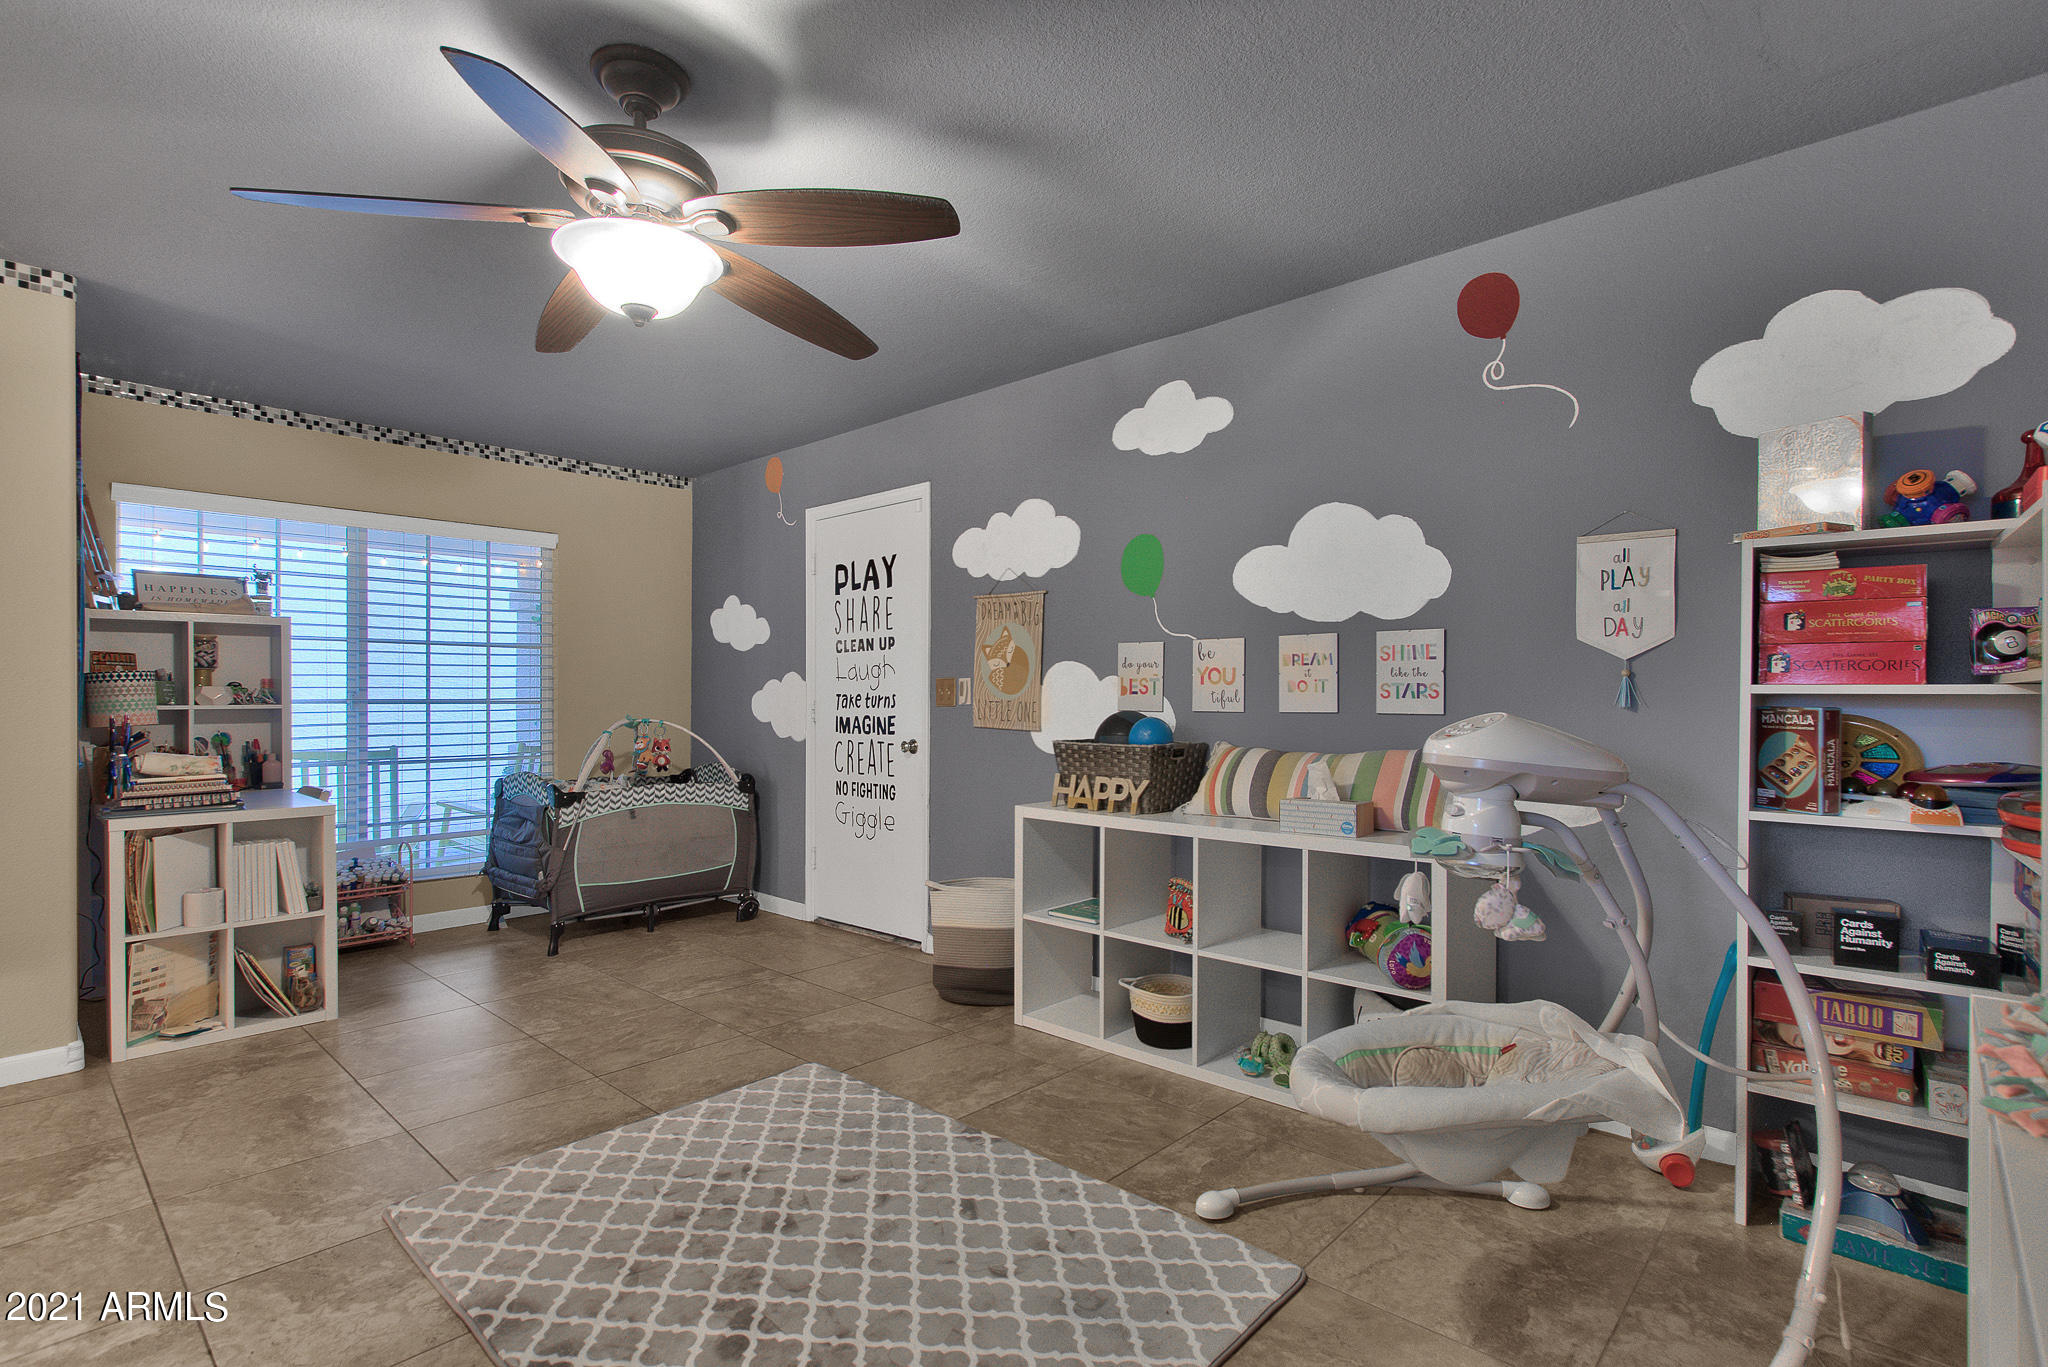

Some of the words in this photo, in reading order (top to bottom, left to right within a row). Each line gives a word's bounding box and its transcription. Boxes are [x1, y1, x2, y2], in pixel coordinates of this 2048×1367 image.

[1613, 548, 1630, 564] all
[835, 554, 897, 595] PLAY
[144, 583, 238, 597] HAPPINESS
[1613, 598, 1630, 613] all
[835, 595, 893, 634] SHARE
[1808, 616, 1898, 628] SCATTERGORIES
[836, 638, 874, 653] CLEAN
[879, 636, 895, 651] UP
[1197, 642, 1216, 661] be
[1122, 657, 1134, 668] do
[1136, 660, 1159, 674] your
[1282, 652, 1333, 666] DREAM
[1792, 659, 1921, 672] SCATTERGORIES
[836, 655, 895, 690] Laugh
[1197, 666, 1236, 685] YOU
[1304, 668, 1312, 678] it
[1390, 667, 1410, 678] like
[1412, 667, 1428, 678] the
[1287, 680, 1308, 693] DO
[1379, 682, 1440, 699] STARS
[836, 693, 861, 710] Take
[865, 692, 896, 709] turns
[1210, 689, 1240, 709] tiful
[978, 699, 1011, 721] LITTLE
[1017, 701, 1037, 723] ONE
[1761, 713, 1815, 726] MANCALA
[835, 715, 896, 735] IMAGINE
[835, 739, 894, 777] CREATE
[1826, 738, 1836, 787] MANCALA
[836, 780, 848, 796] NO
[851, 782, 896, 801] FIGHTING
[1051, 773, 1150, 815] HAPPY
[835, 801, 895, 840] Giggle
[1840, 918, 1874, 929] Cards
[1840, 927, 1883, 938] Against
[2000, 927, 2019, 938] Cards
[1840, 935, 1894, 949] Humanity
[1935, 952, 1960, 961] Cards
[1935, 959, 1967, 968] Against
[1935, 964, 1975, 976] Humanity
[1821, 999, 1883, 1028] TABOO
